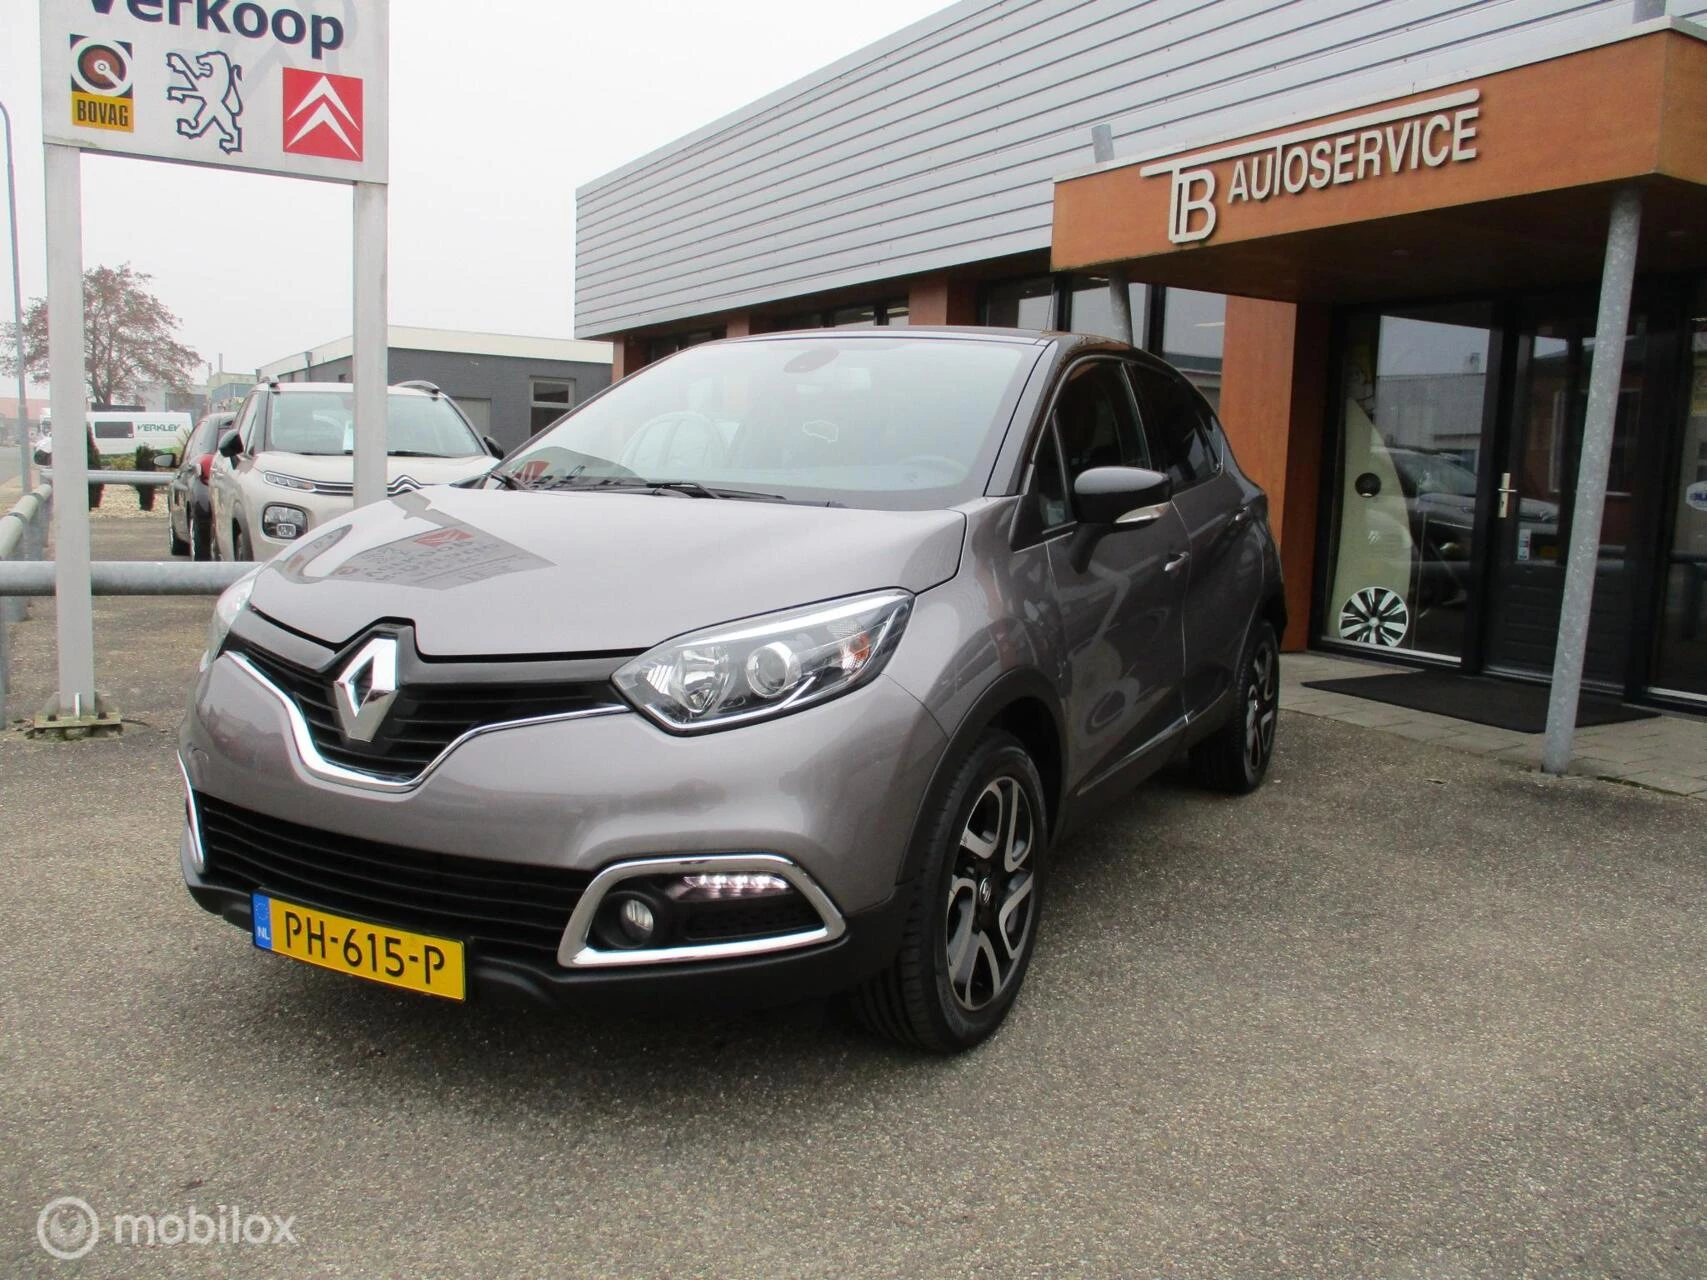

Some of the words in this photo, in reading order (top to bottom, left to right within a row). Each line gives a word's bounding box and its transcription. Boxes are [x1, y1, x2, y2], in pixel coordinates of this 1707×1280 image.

[76, 100, 129, 127] BOVAG
[1139, 158, 1218, 244] TB
[1227, 106, 1481, 204] AUTOSERVICE
[257, 926, 270, 941] NL
[284, 911, 446, 985] PH-615-P
